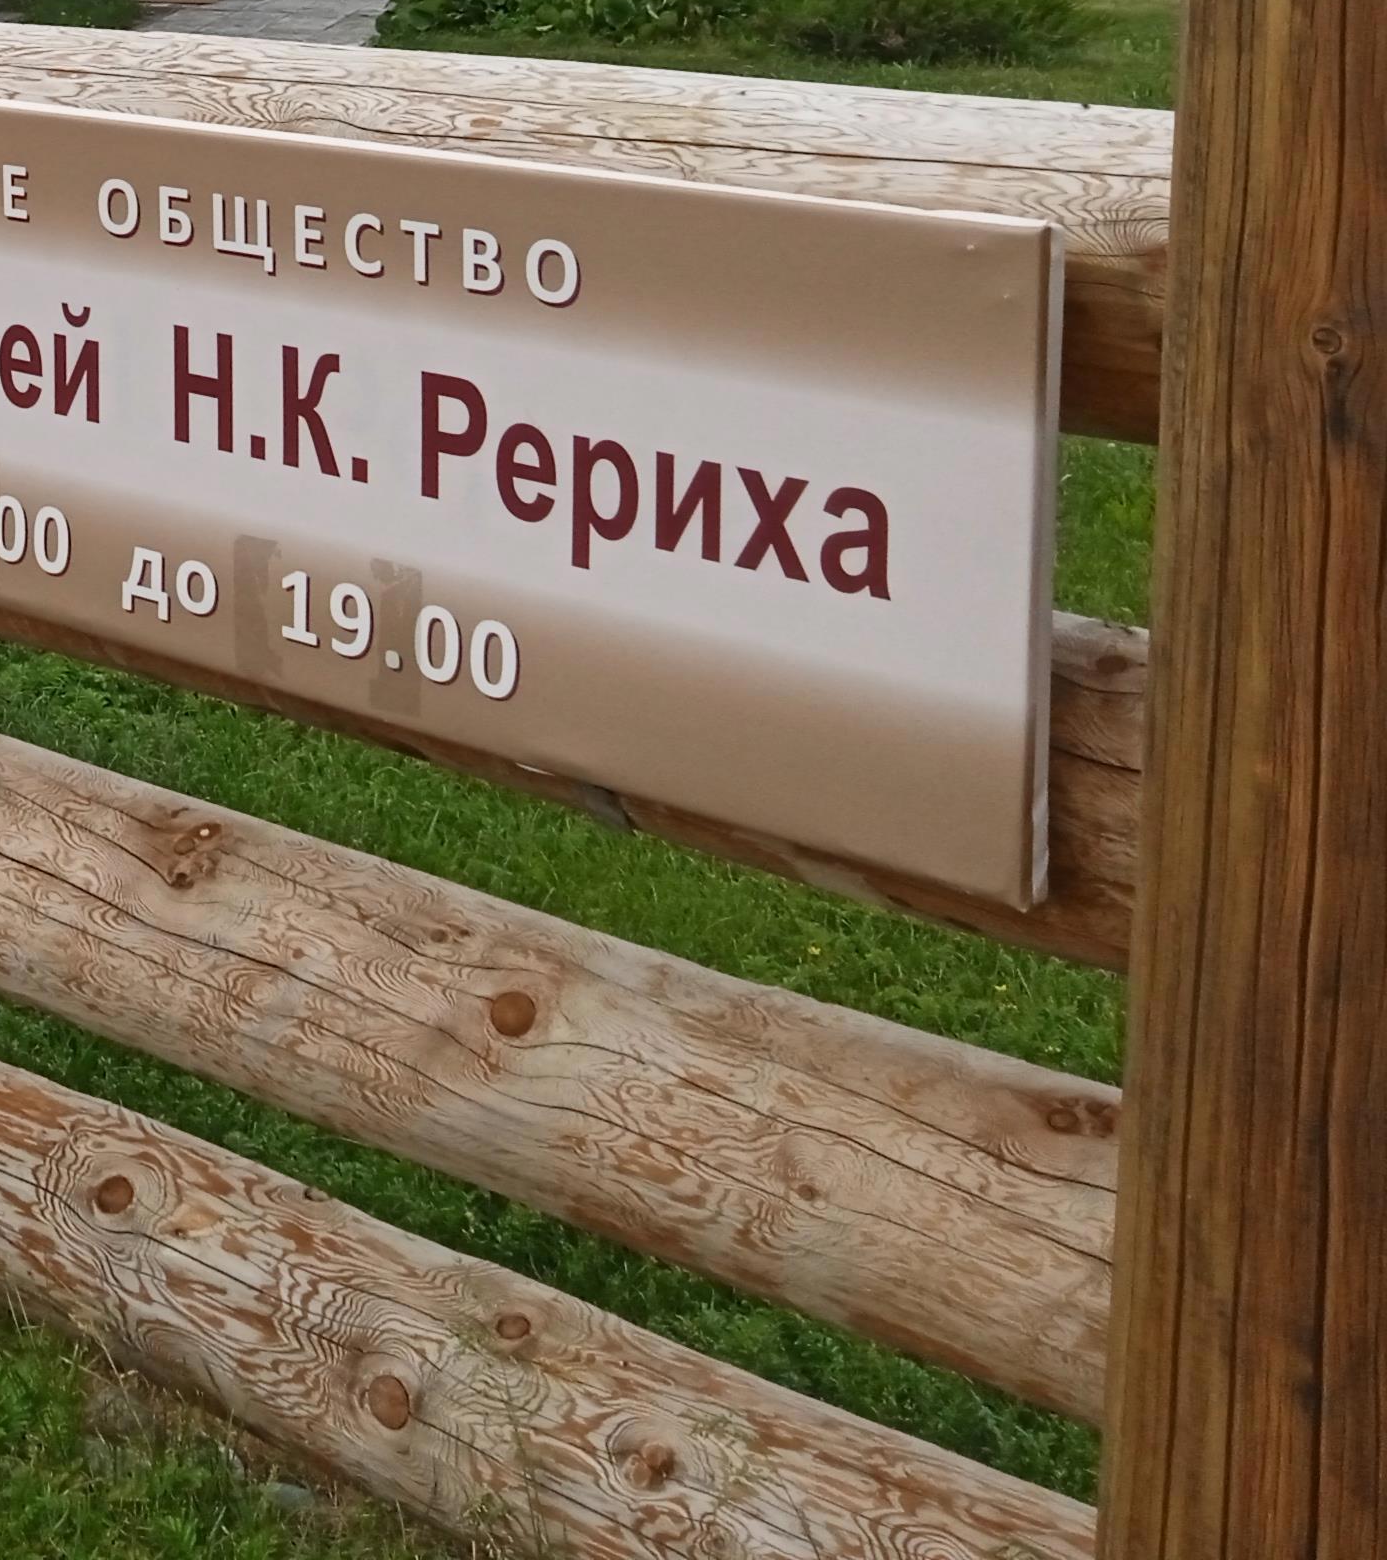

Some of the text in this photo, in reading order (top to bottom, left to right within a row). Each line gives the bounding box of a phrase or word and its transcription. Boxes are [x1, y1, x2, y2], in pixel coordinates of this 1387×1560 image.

[98, 178, 582, 307] ОБЩЕСТВО
[173, 325, 369, 483] Н.К.
[420, 371, 893, 601] Рериха
[121, 545, 219, 623] до
[281, 570, 520, 701] 19.00
